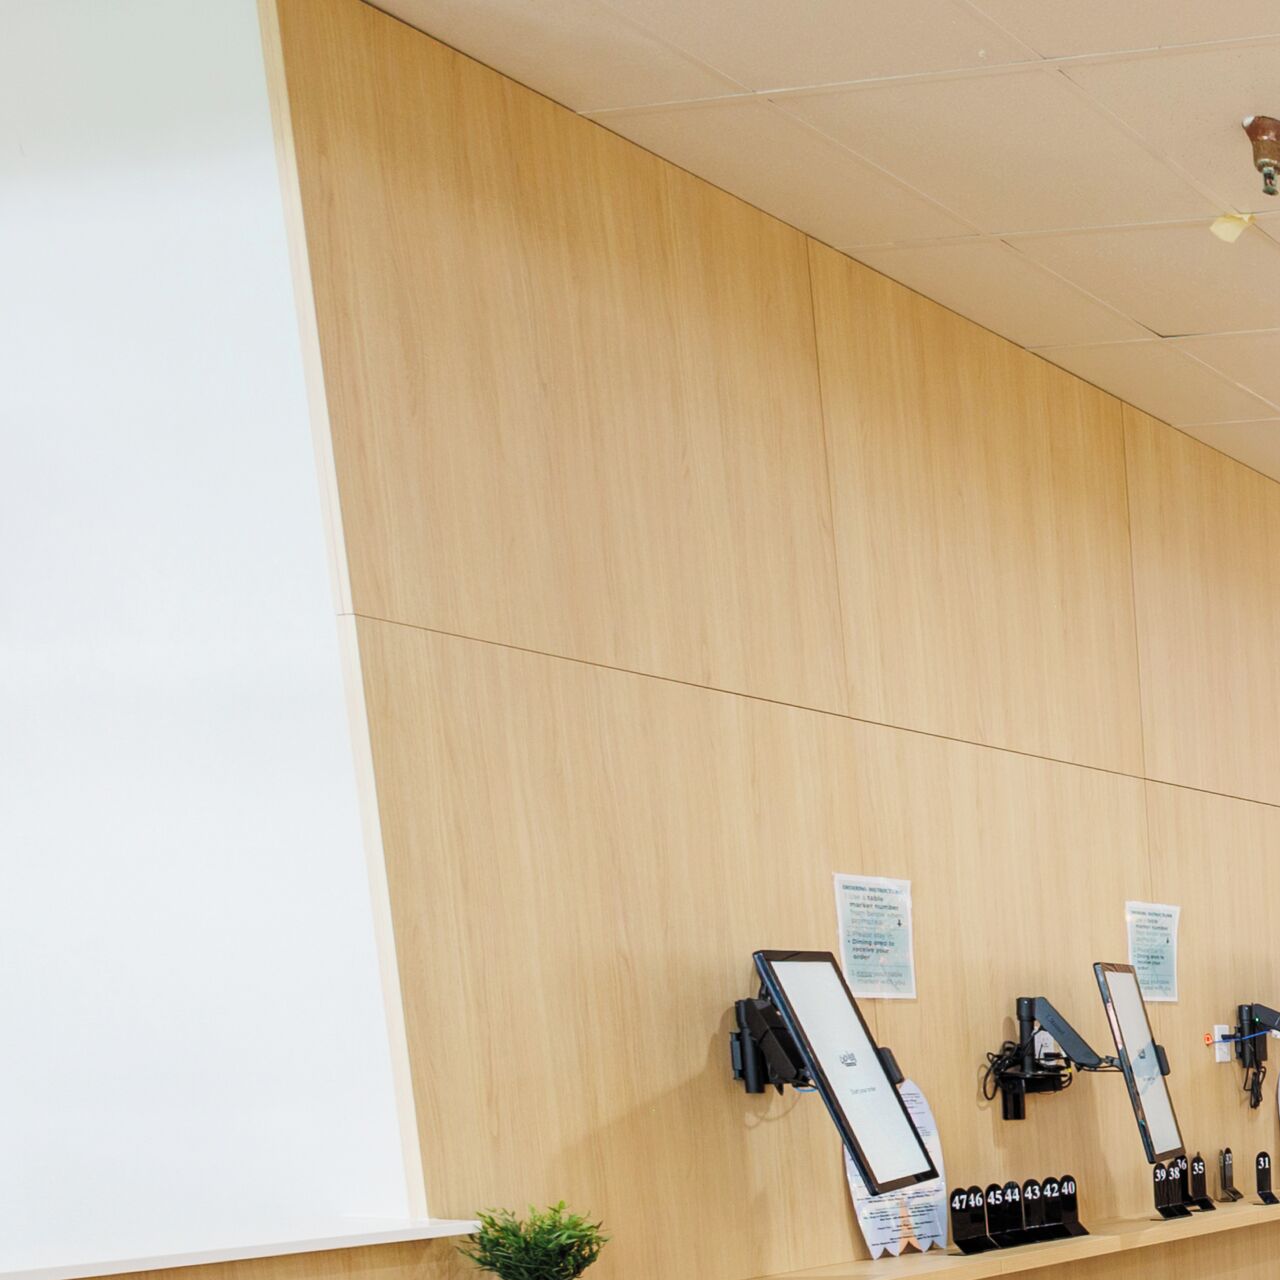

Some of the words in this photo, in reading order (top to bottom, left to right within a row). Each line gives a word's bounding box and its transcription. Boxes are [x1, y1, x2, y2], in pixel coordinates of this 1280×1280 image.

[1193, 1162, 1204, 1175] 35
[1258, 1157, 1269, 1169] 31
[1155, 1168, 1166, 1182] 39
[1168, 1167, 1180, 1180] 38
[1004, 1187, 1020, 1202] 44
[1024, 1185, 1040, 1200] 43
[1043, 1183, 1059, 1198] 42
[1061, 1181, 1076, 1195] 40
[952, 1194, 967, 1210] 47
[968, 1192, 983, 1207] 46
[987, 1190, 1003, 1205] 45
